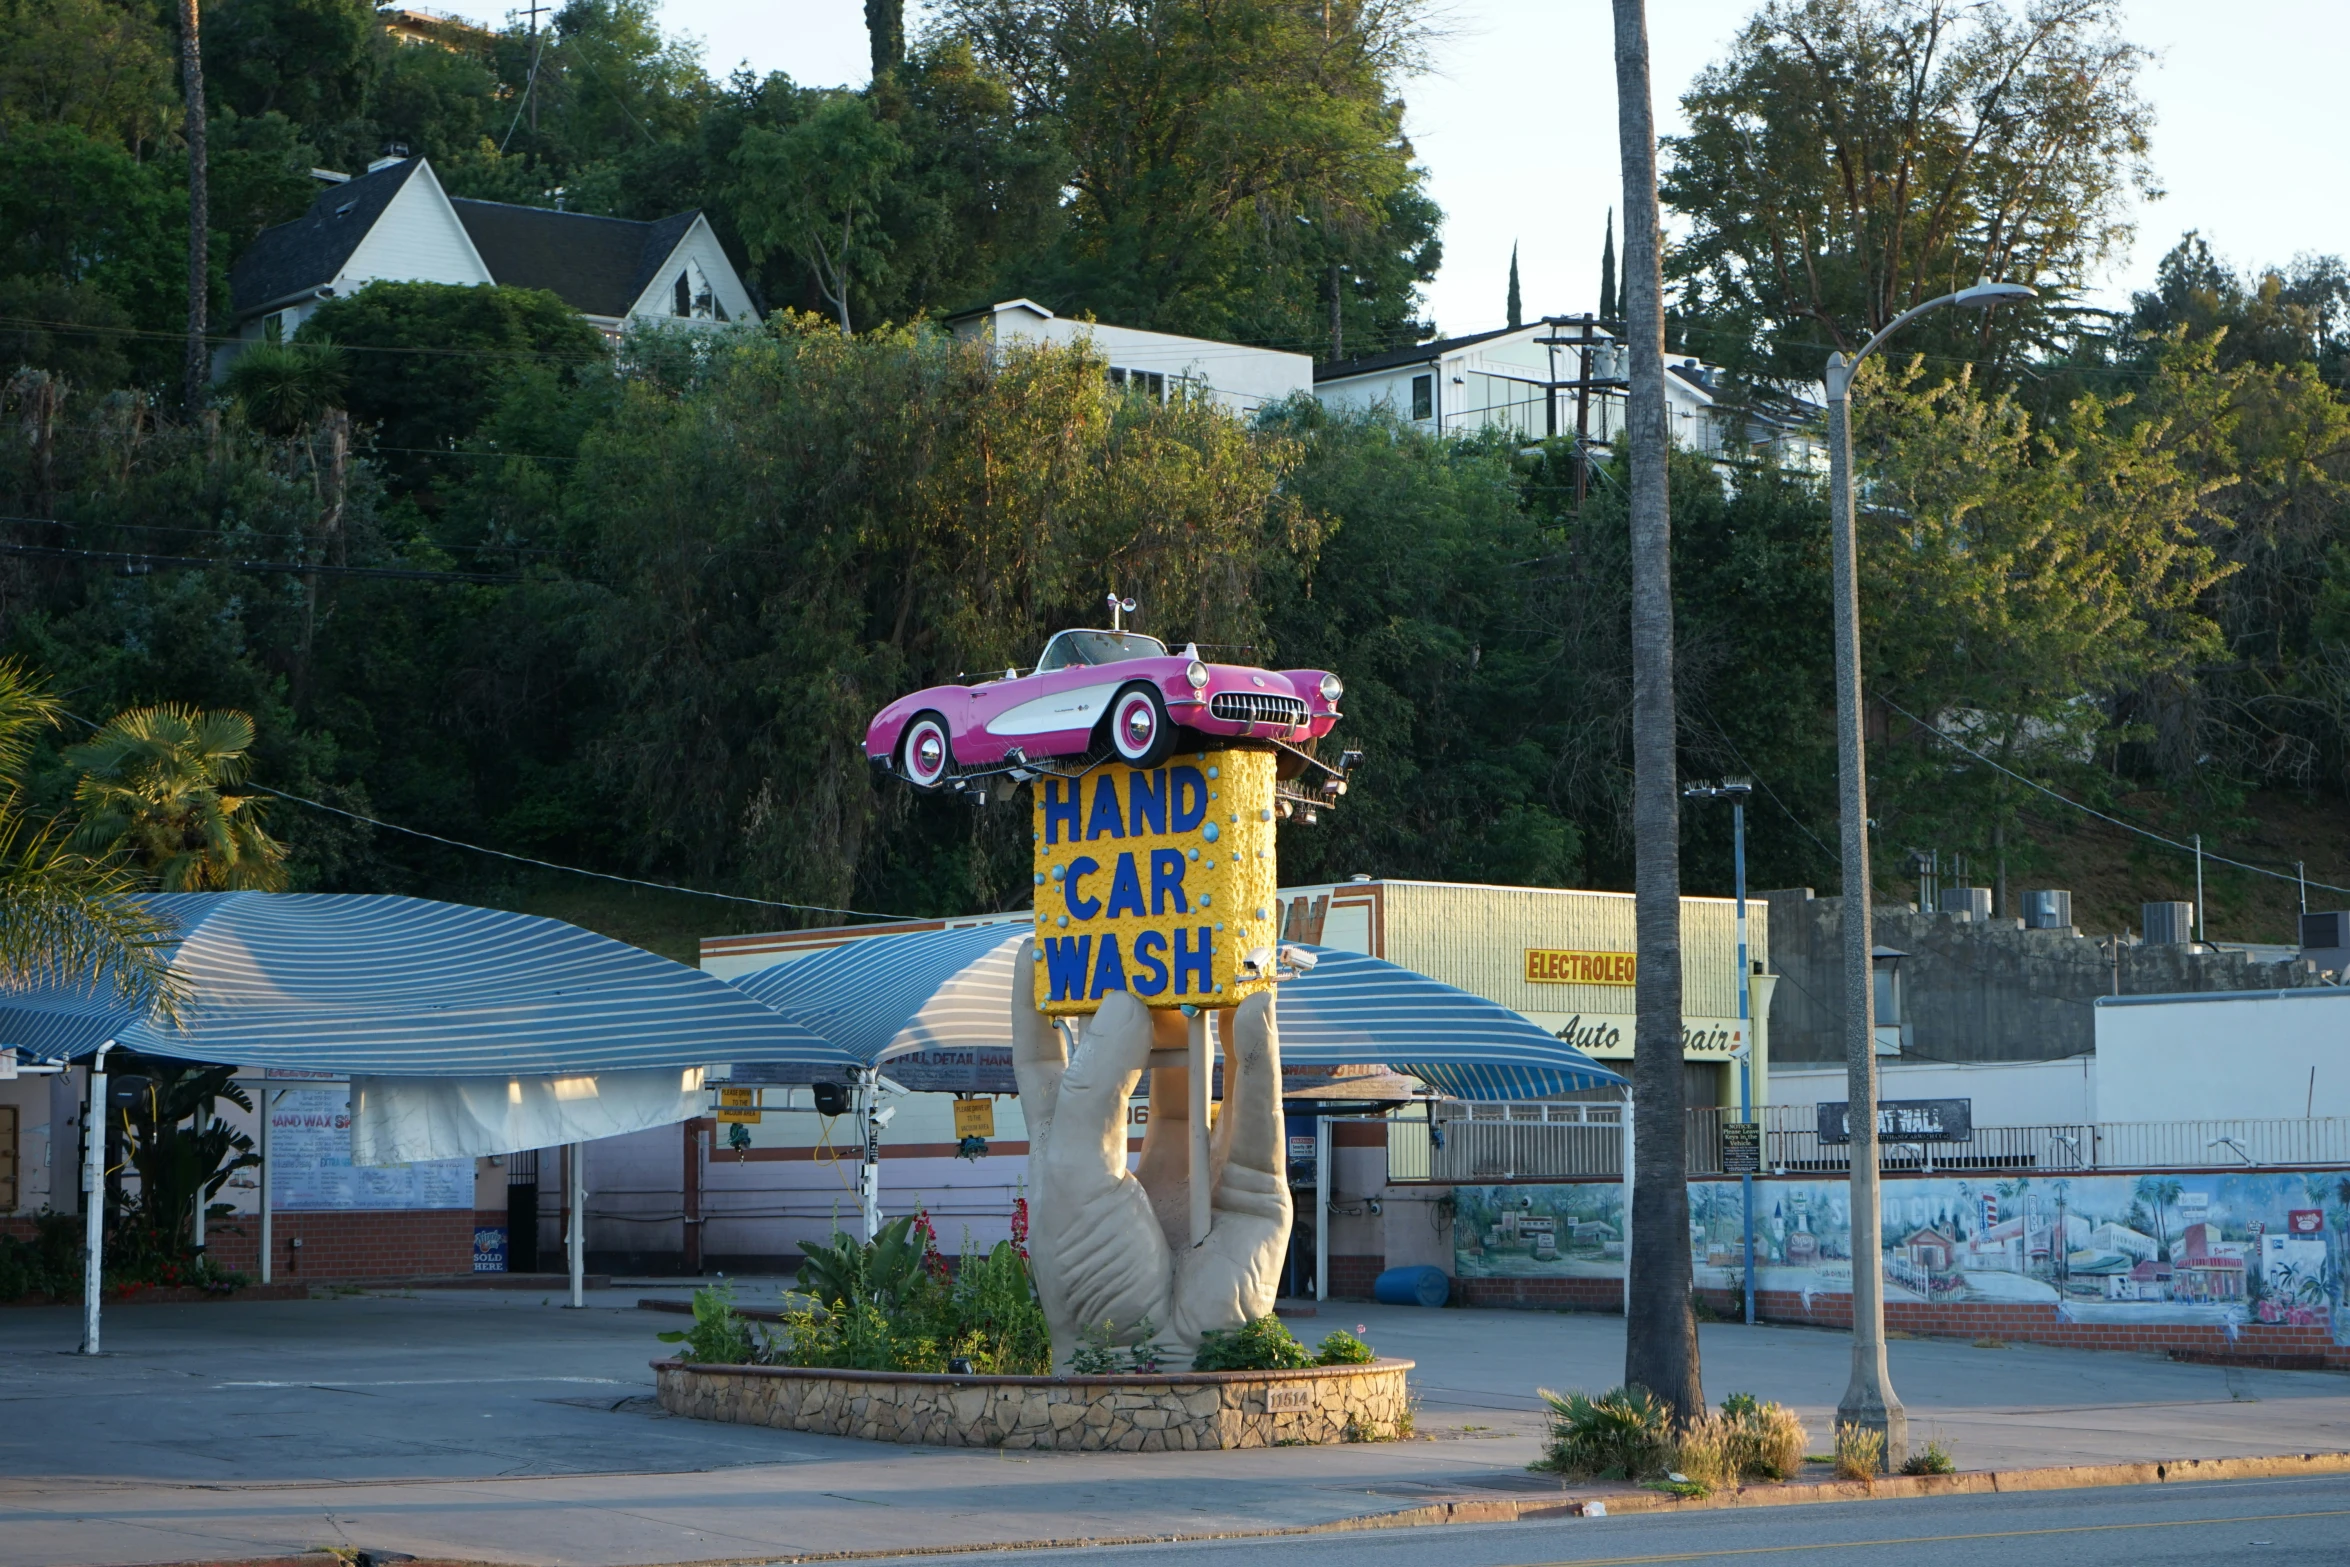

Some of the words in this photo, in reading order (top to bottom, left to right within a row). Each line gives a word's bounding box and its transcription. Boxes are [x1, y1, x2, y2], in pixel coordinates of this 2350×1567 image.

[1045, 766, 1208, 845] HAND
[1064, 848, 1188, 921] CAR
[1044, 927, 1212, 1002] WASH
[1555, 1014, 1621, 1049] Auto
[1682, 1023, 1728, 1051] pair
[932, 1052, 976, 1066] DETAIL
[739, 1099, 748, 1107] THE
[956, 1105, 972, 1113] PLEASE
[303, 1114, 331, 1128] WAX
[473, 1253, 503, 1262] SOLD
[474, 1262, 503, 1271] HERE
[1270, 1391, 1309, 1409] 11514
